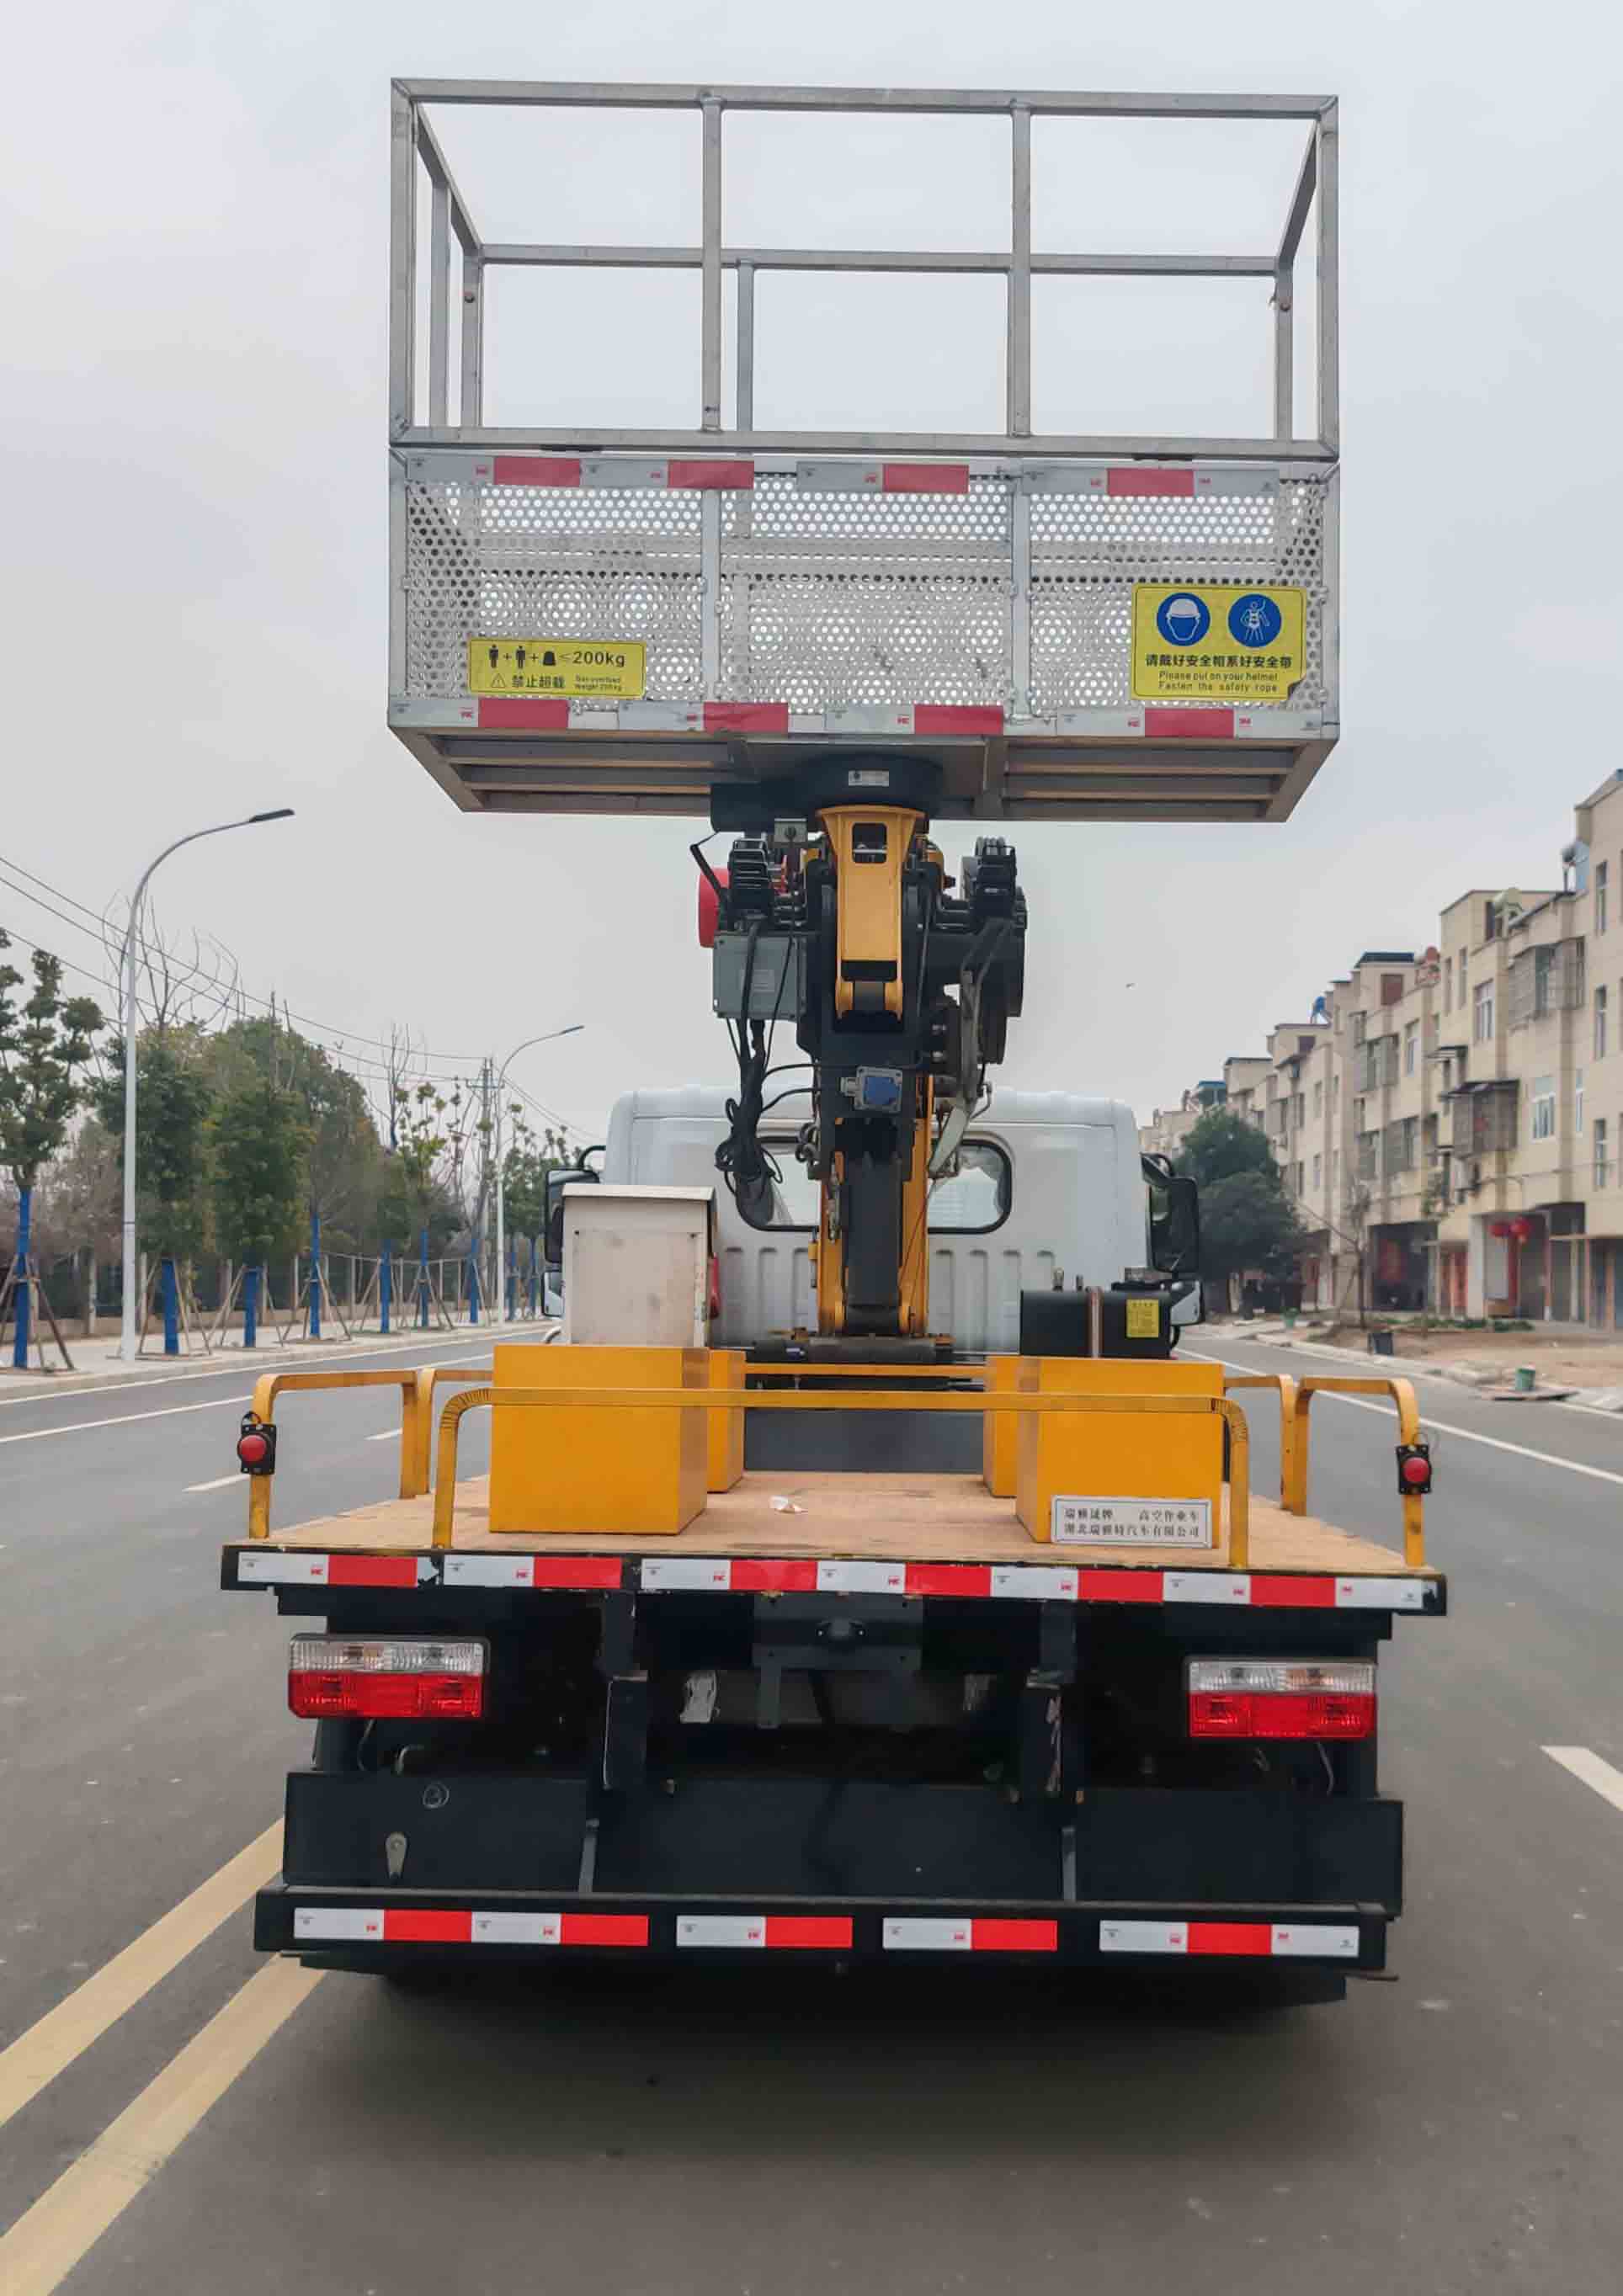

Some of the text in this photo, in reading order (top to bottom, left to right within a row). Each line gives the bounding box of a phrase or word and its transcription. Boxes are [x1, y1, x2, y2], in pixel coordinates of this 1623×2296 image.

[1146, 654, 1292, 668] 请戴好安全帽系好安全带
[512, 674, 566, 688] 禁止超载
[1158, 670, 1189, 680] Please
[1193, 672, 1207, 682] put
[1225, 672, 1244, 683] your
[1246, 672, 1278, 681] helmet
[1158, 681, 1277, 693] Fasten the safety rope
